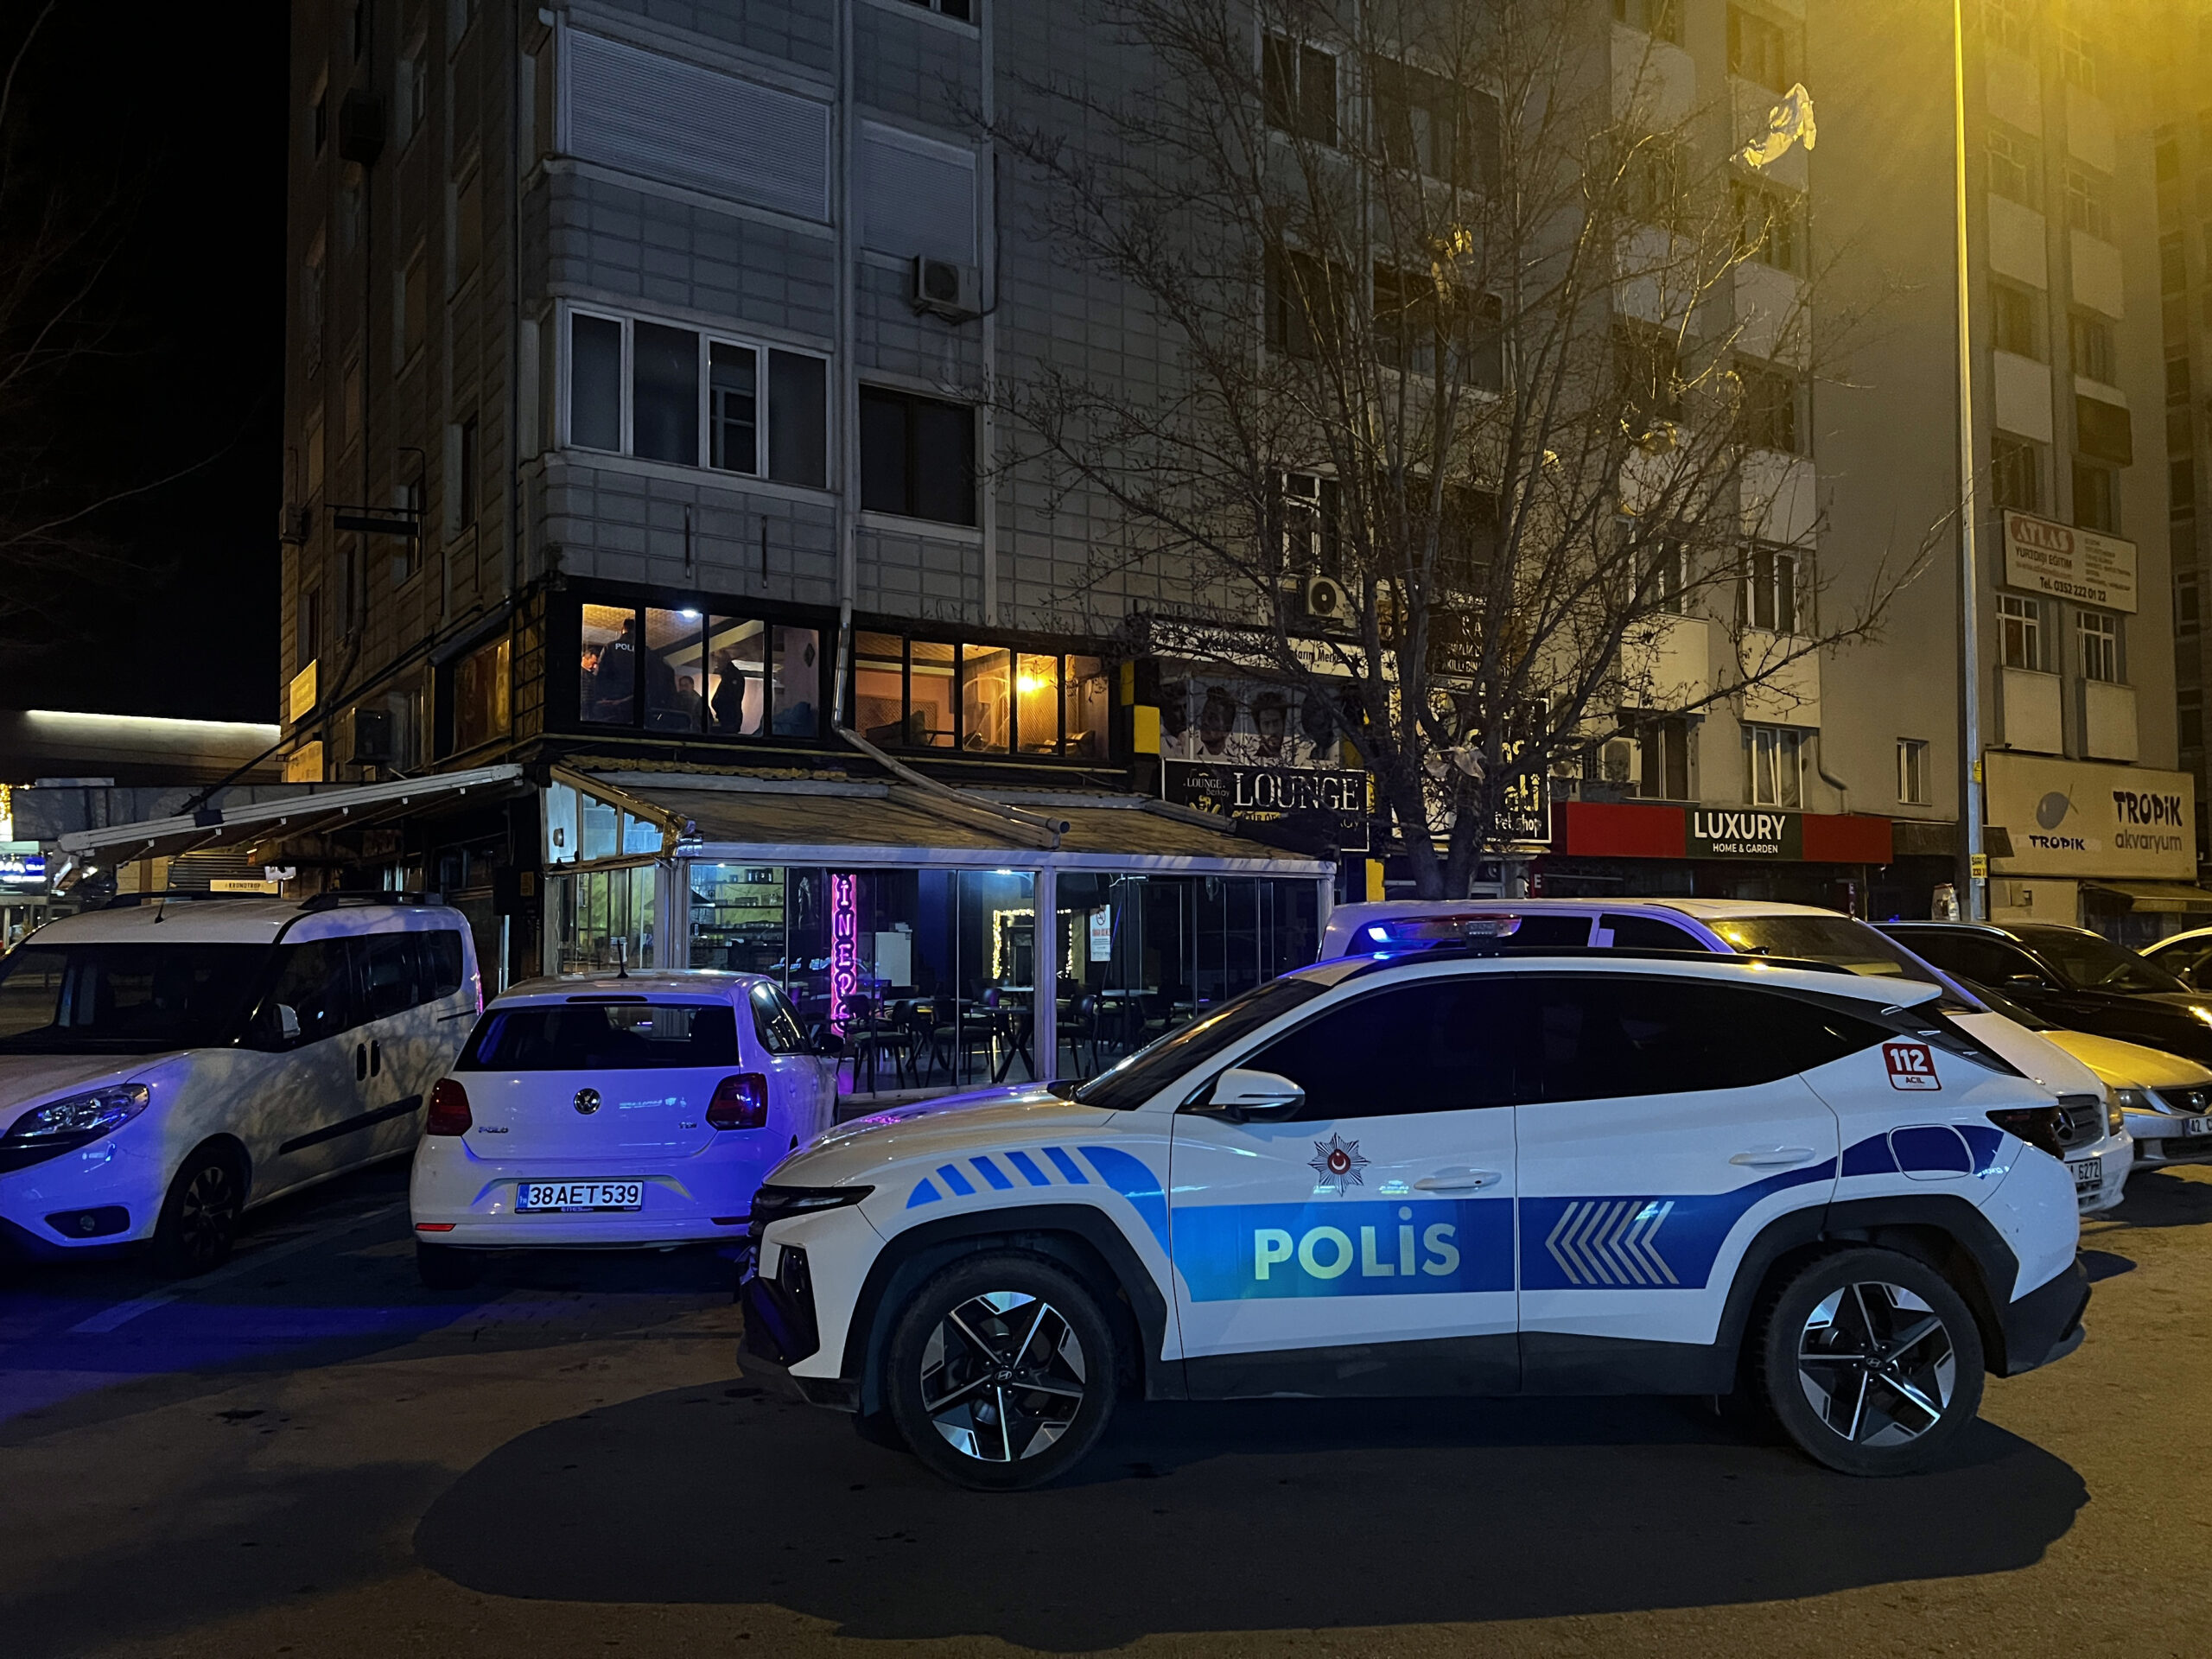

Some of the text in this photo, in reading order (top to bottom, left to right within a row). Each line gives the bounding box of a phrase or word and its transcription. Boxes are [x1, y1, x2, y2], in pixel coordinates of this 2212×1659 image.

[2017, 518, 2069, 551] ATLAS
[2054, 581, 2072, 594] 0352
[2074, 585, 2087, 598] 222
[2088, 587, 2097, 600] 01
[2098, 590, 2107, 602] 22
[1187, 777, 1222, 789] LOUNGE
[1233, 772, 1359, 810] LOUNGE
[1694, 811, 1785, 841] LUXURY
[1713, 842, 1778, 854] HOME & GARDEN
[2115, 830, 2183, 855] akvaryum
[1890, 1048, 1929, 1072] 112
